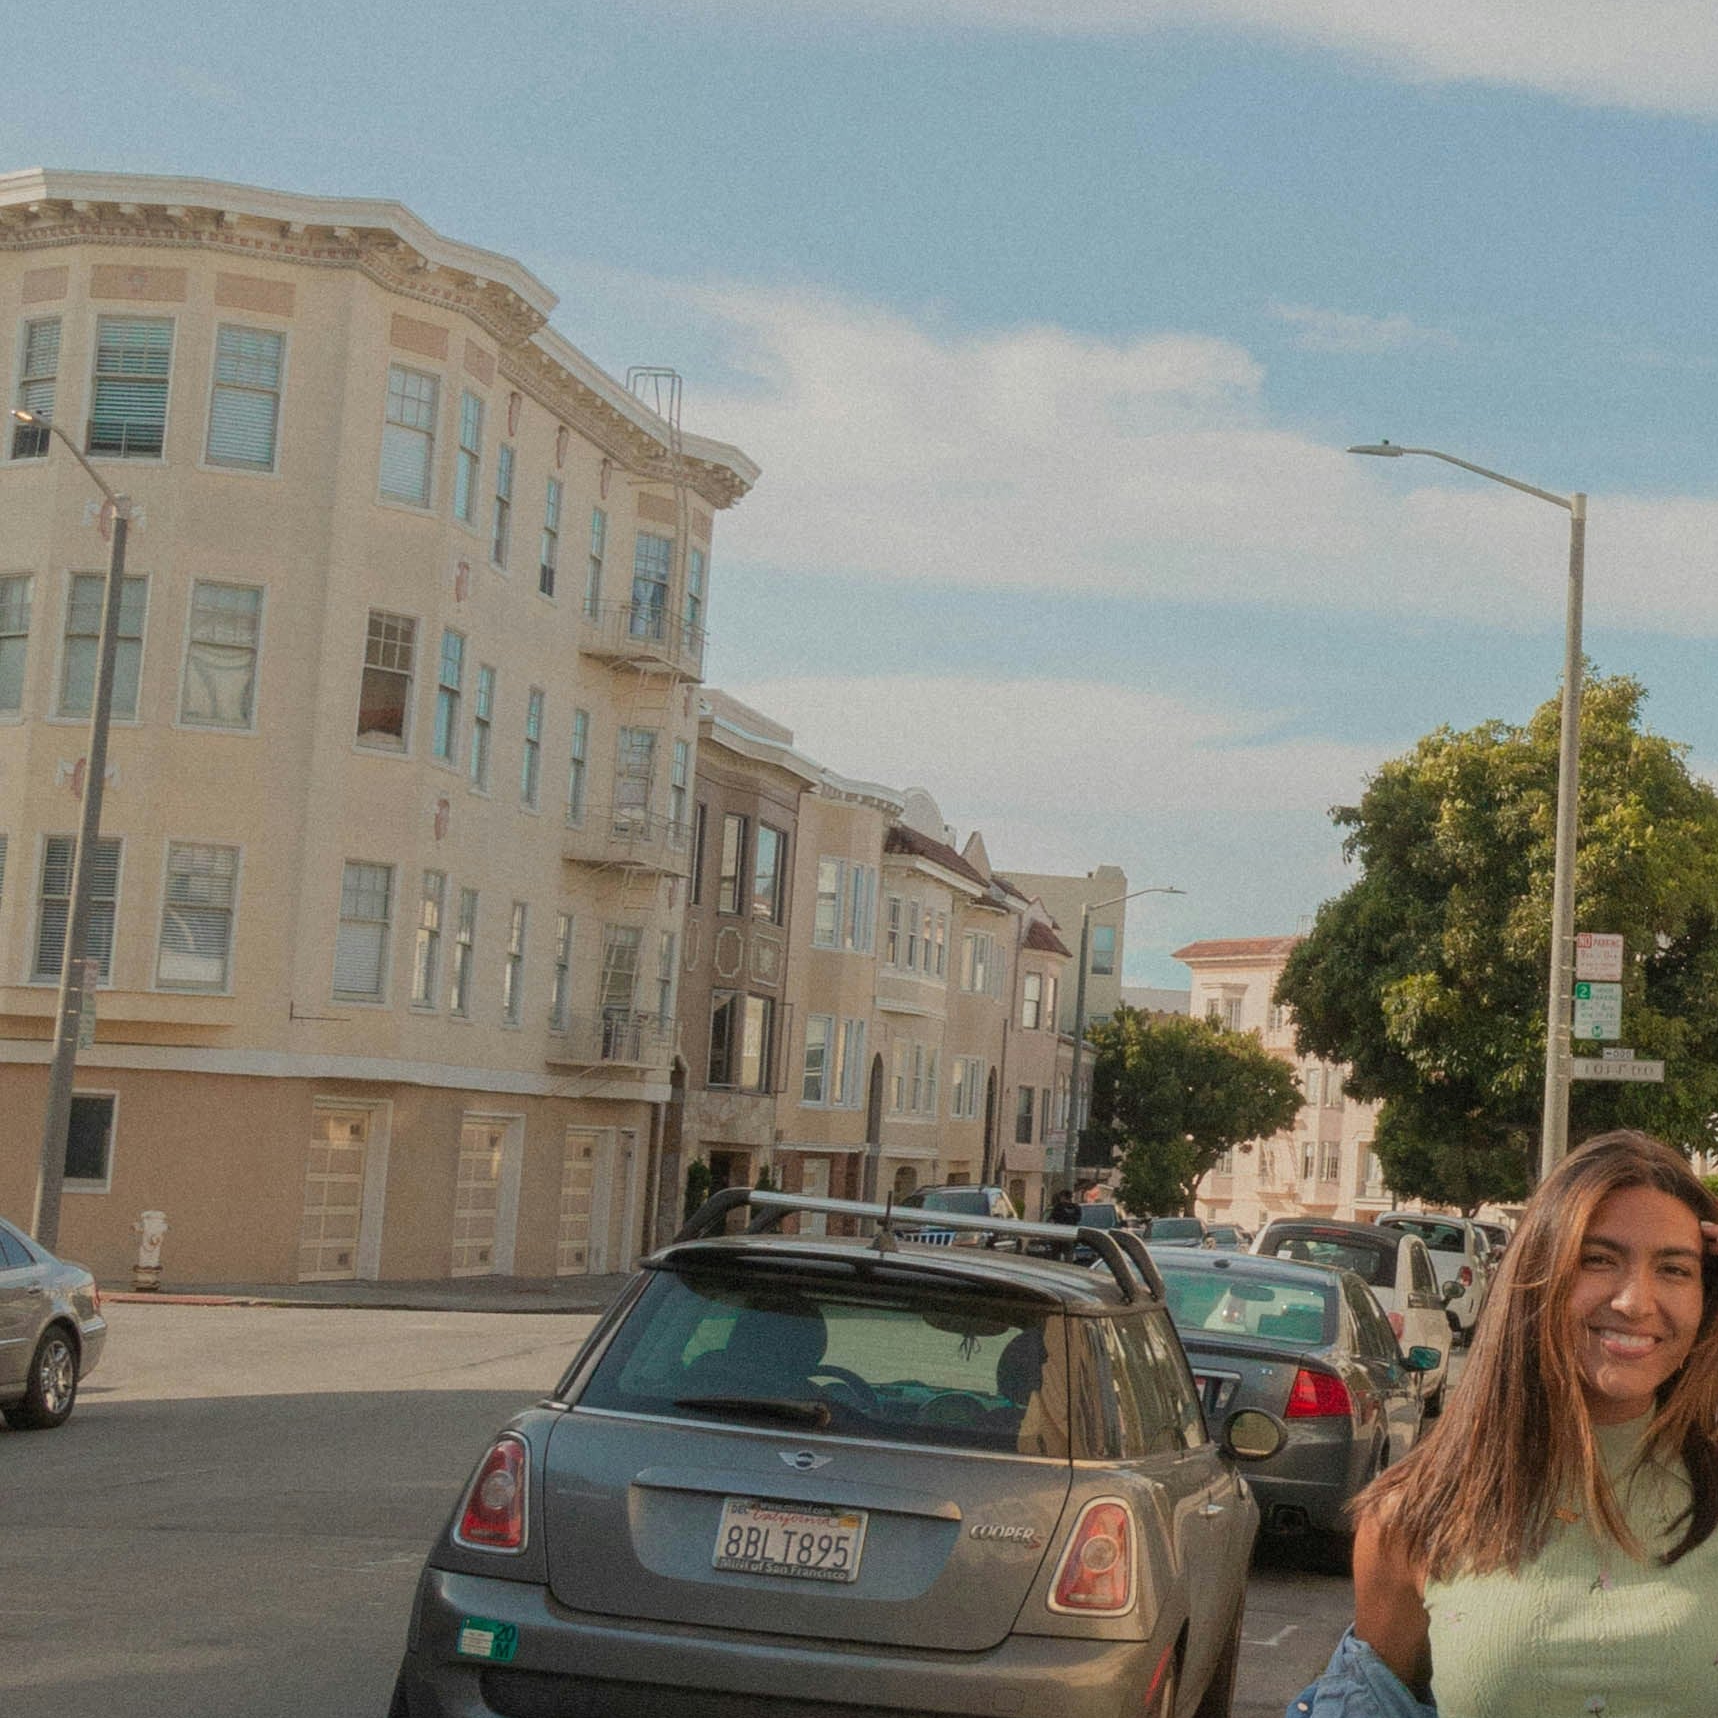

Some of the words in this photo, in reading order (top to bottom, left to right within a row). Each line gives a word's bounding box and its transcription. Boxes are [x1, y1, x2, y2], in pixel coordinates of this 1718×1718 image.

[1578, 936, 1591, 947] NO
[1579, 985, 1588, 998] 2
[969, 1524, 1034, 1540] COOPER
[725, 1525, 850, 1568] 8BLT895
[750, 1561, 763, 1572] of
[765, 1563, 788, 1575] San
[790, 1564, 847, 1580] Francisco
[494, 1623, 516, 1642] 20
[495, 1641, 509, 1658] M
